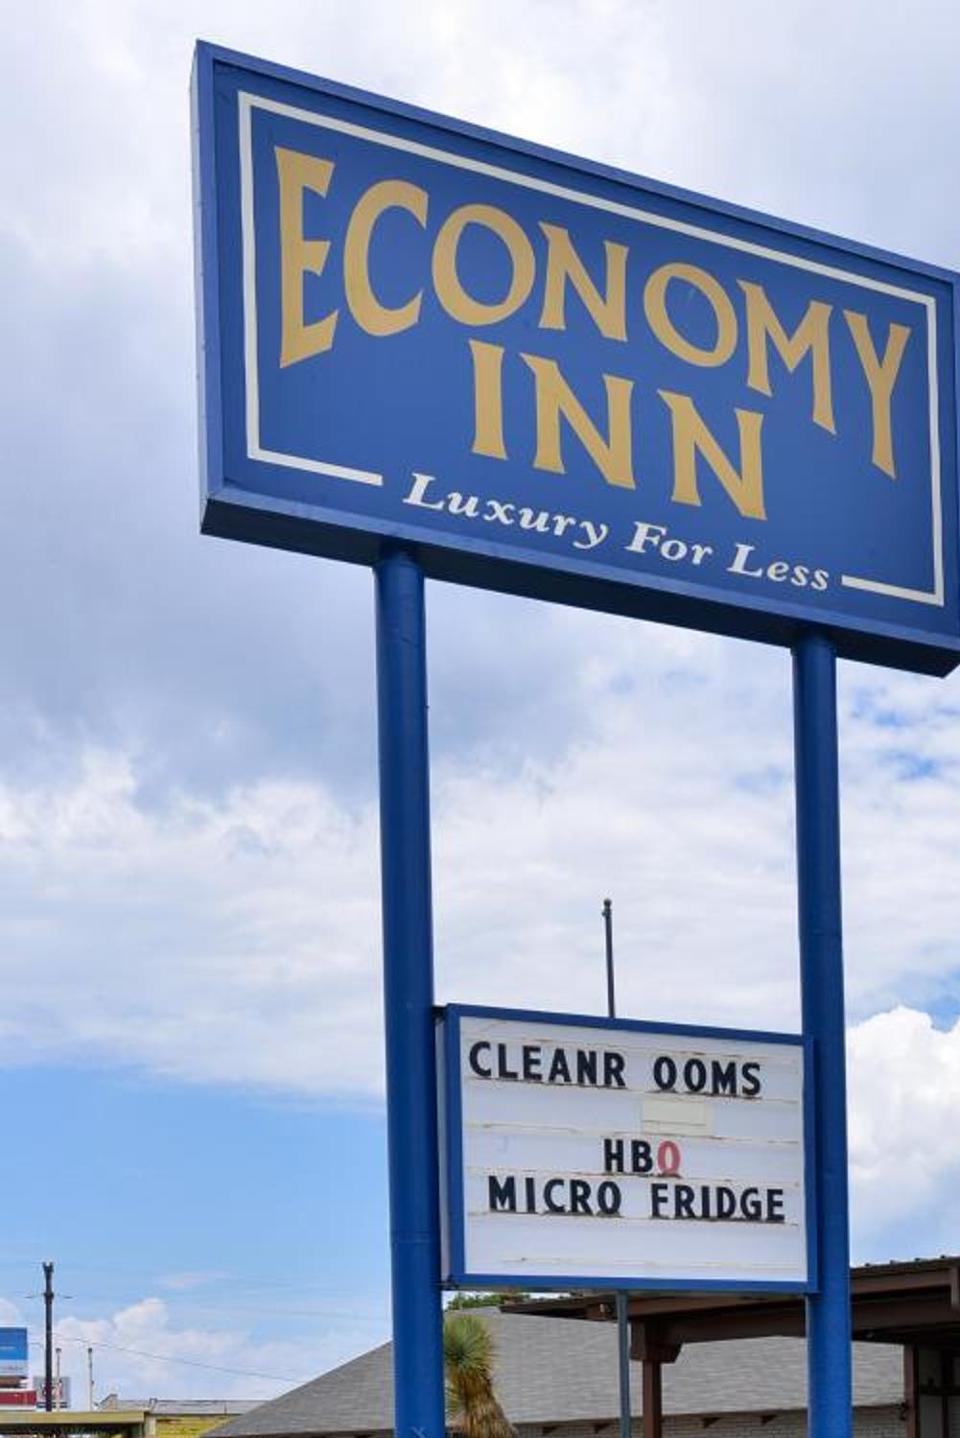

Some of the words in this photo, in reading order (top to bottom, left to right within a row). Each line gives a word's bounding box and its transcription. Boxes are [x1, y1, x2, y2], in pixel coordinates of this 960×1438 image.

[274, 146, 911, 480] ECONOMY
[469, 340, 767, 521] INN
[402, 472, 609, 550] Luxury
[624, 521, 713, 566] For
[726, 543, 830, 592] Less
[468, 1040, 626, 1088] CLEANR
[653, 1055, 762, 1097] OOMS
[488, 1175, 622, 1215] MICRO
[651, 1182, 786, 1222] FRIDGE
[603, 1138, 682, 1176] HBO
